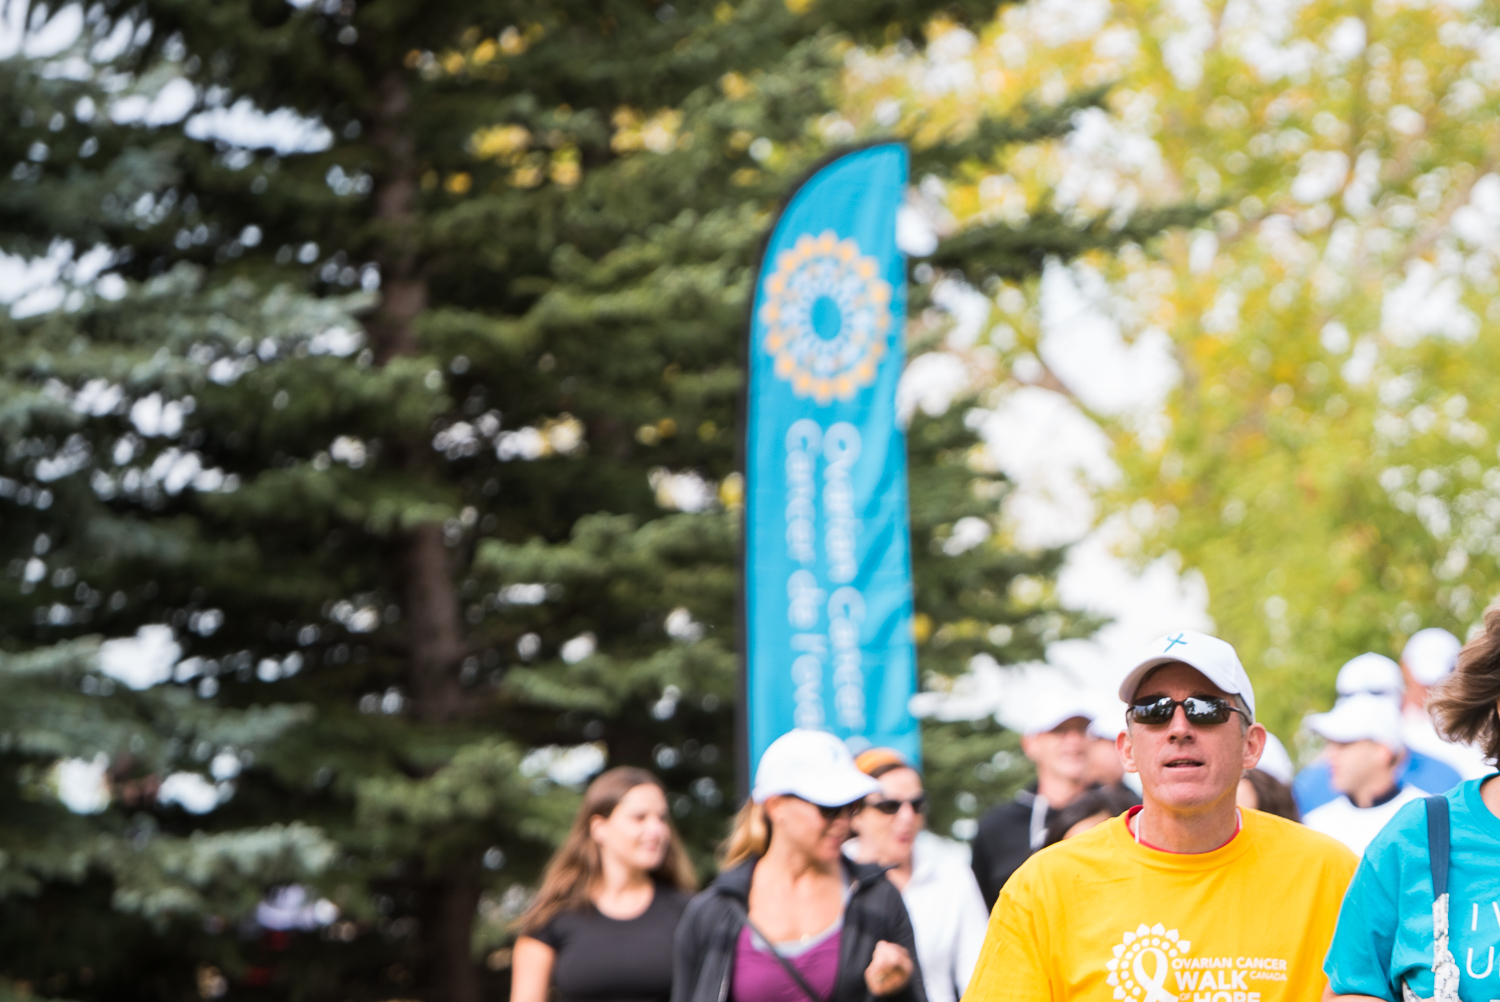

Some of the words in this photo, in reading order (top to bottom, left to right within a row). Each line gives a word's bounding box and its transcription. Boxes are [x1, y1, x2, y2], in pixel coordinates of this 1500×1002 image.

[1471, 902, 1479, 931] I
[1172, 958, 1232, 970] OVARIAN
[1236, 957, 1287, 971] CANCER
[1175, 970, 1248, 990] WALK
[1250, 970, 1287, 981] CANADA
[1180, 993, 1191, 1001] OF
